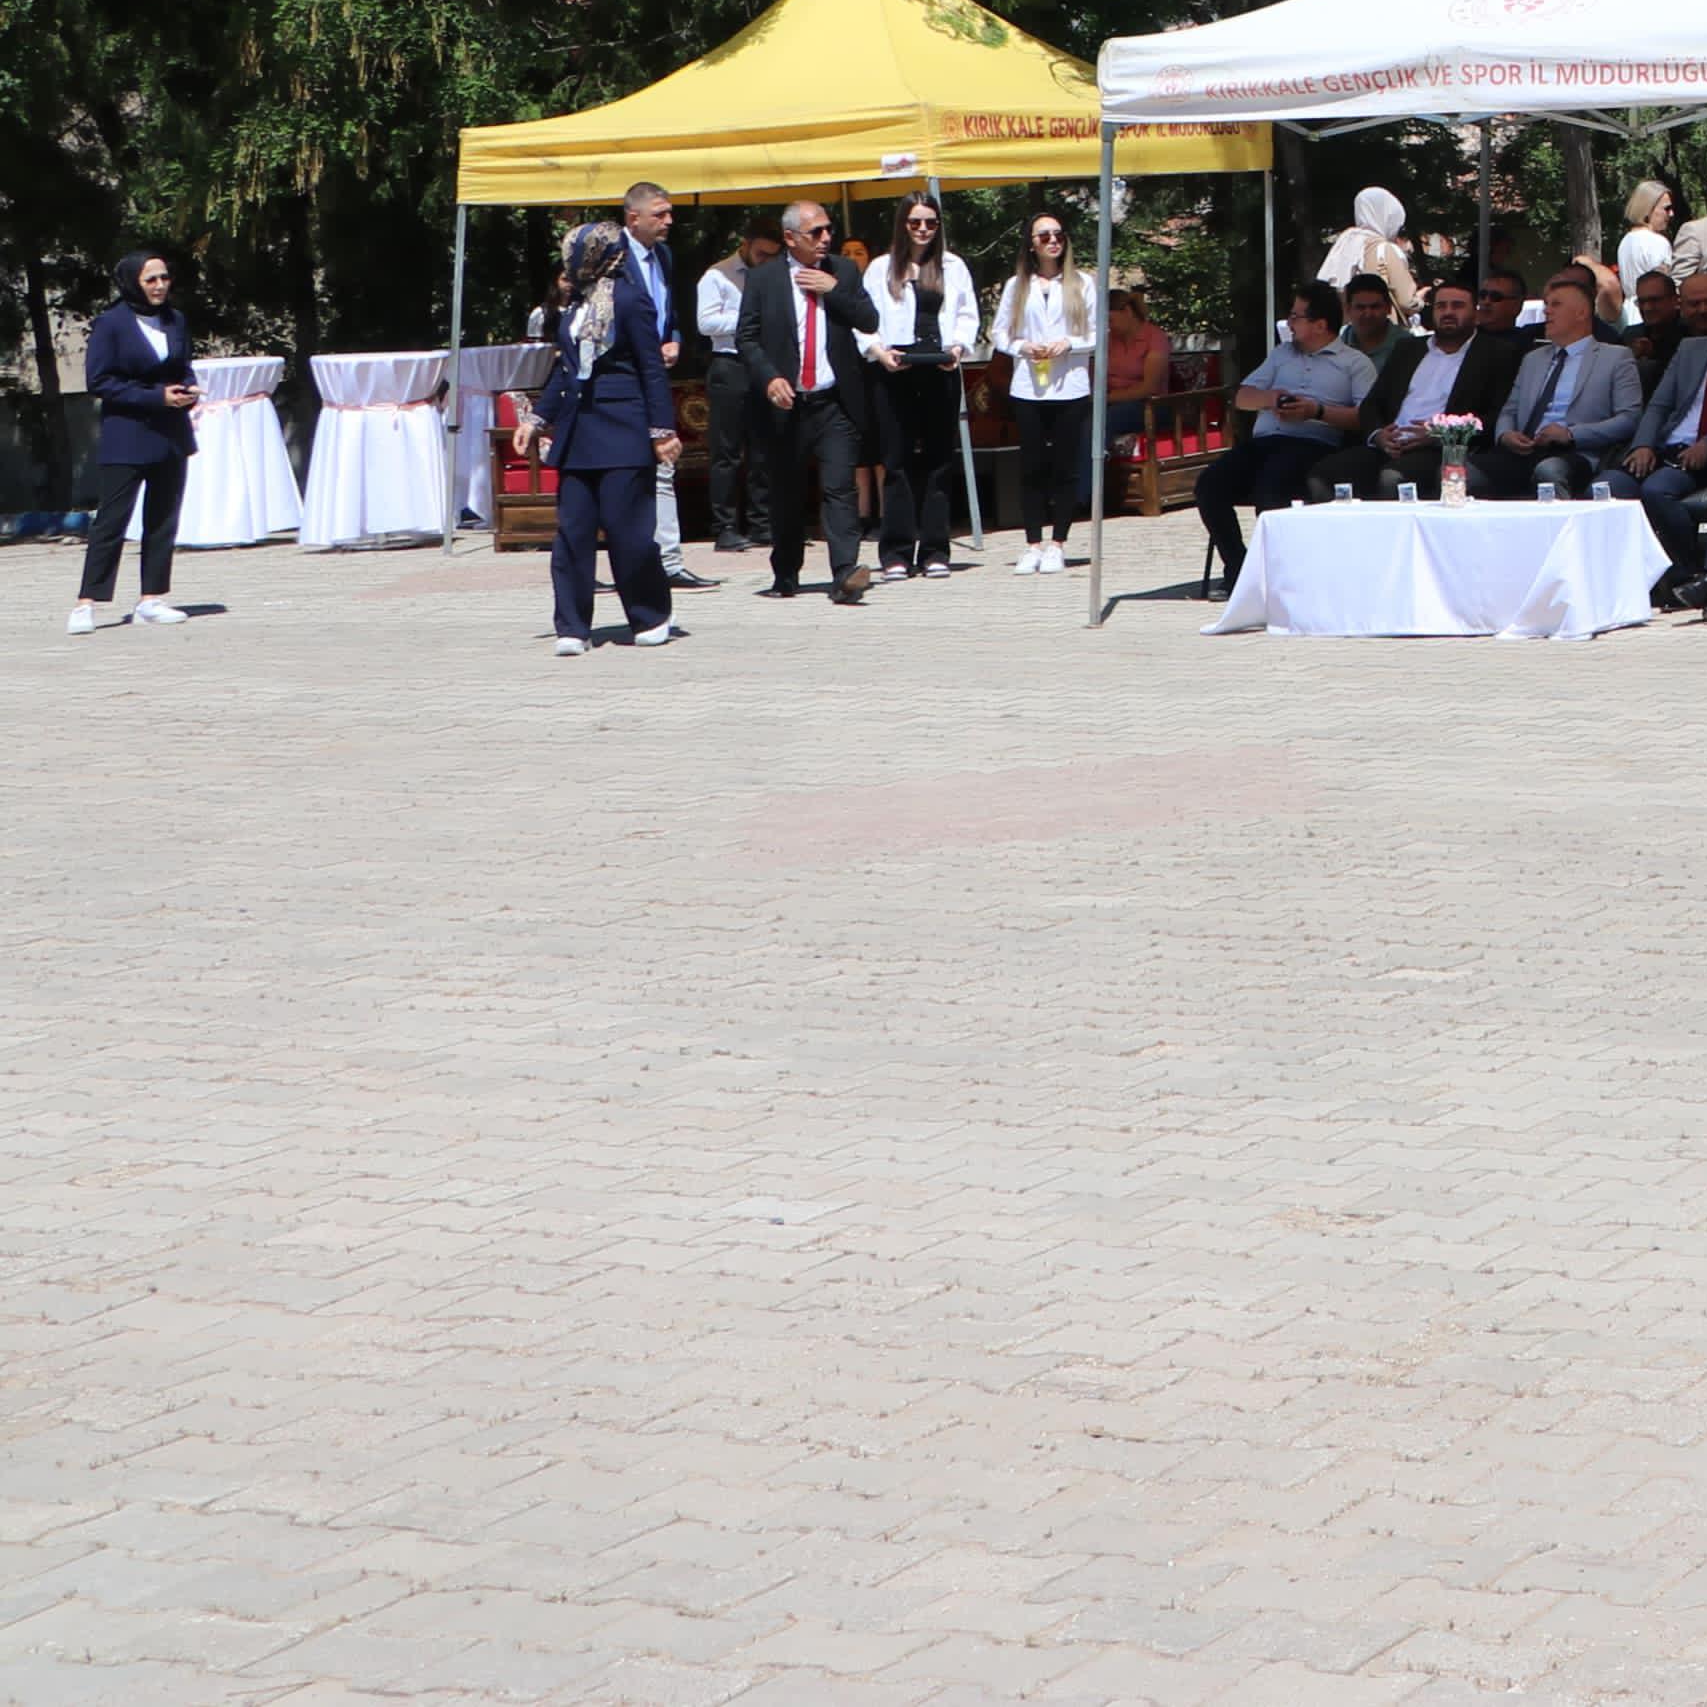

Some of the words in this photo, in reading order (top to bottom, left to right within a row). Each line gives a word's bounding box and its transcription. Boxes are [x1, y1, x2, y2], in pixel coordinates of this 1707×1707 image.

[1204, 75, 1318, 101] KIRIKKALE
[1322, 65, 1419, 95] GENÇLİK
[1423, 62, 1452, 87] VE
[1461, 62, 1523, 86] SPOR
[1529, 58, 1548, 85] İL
